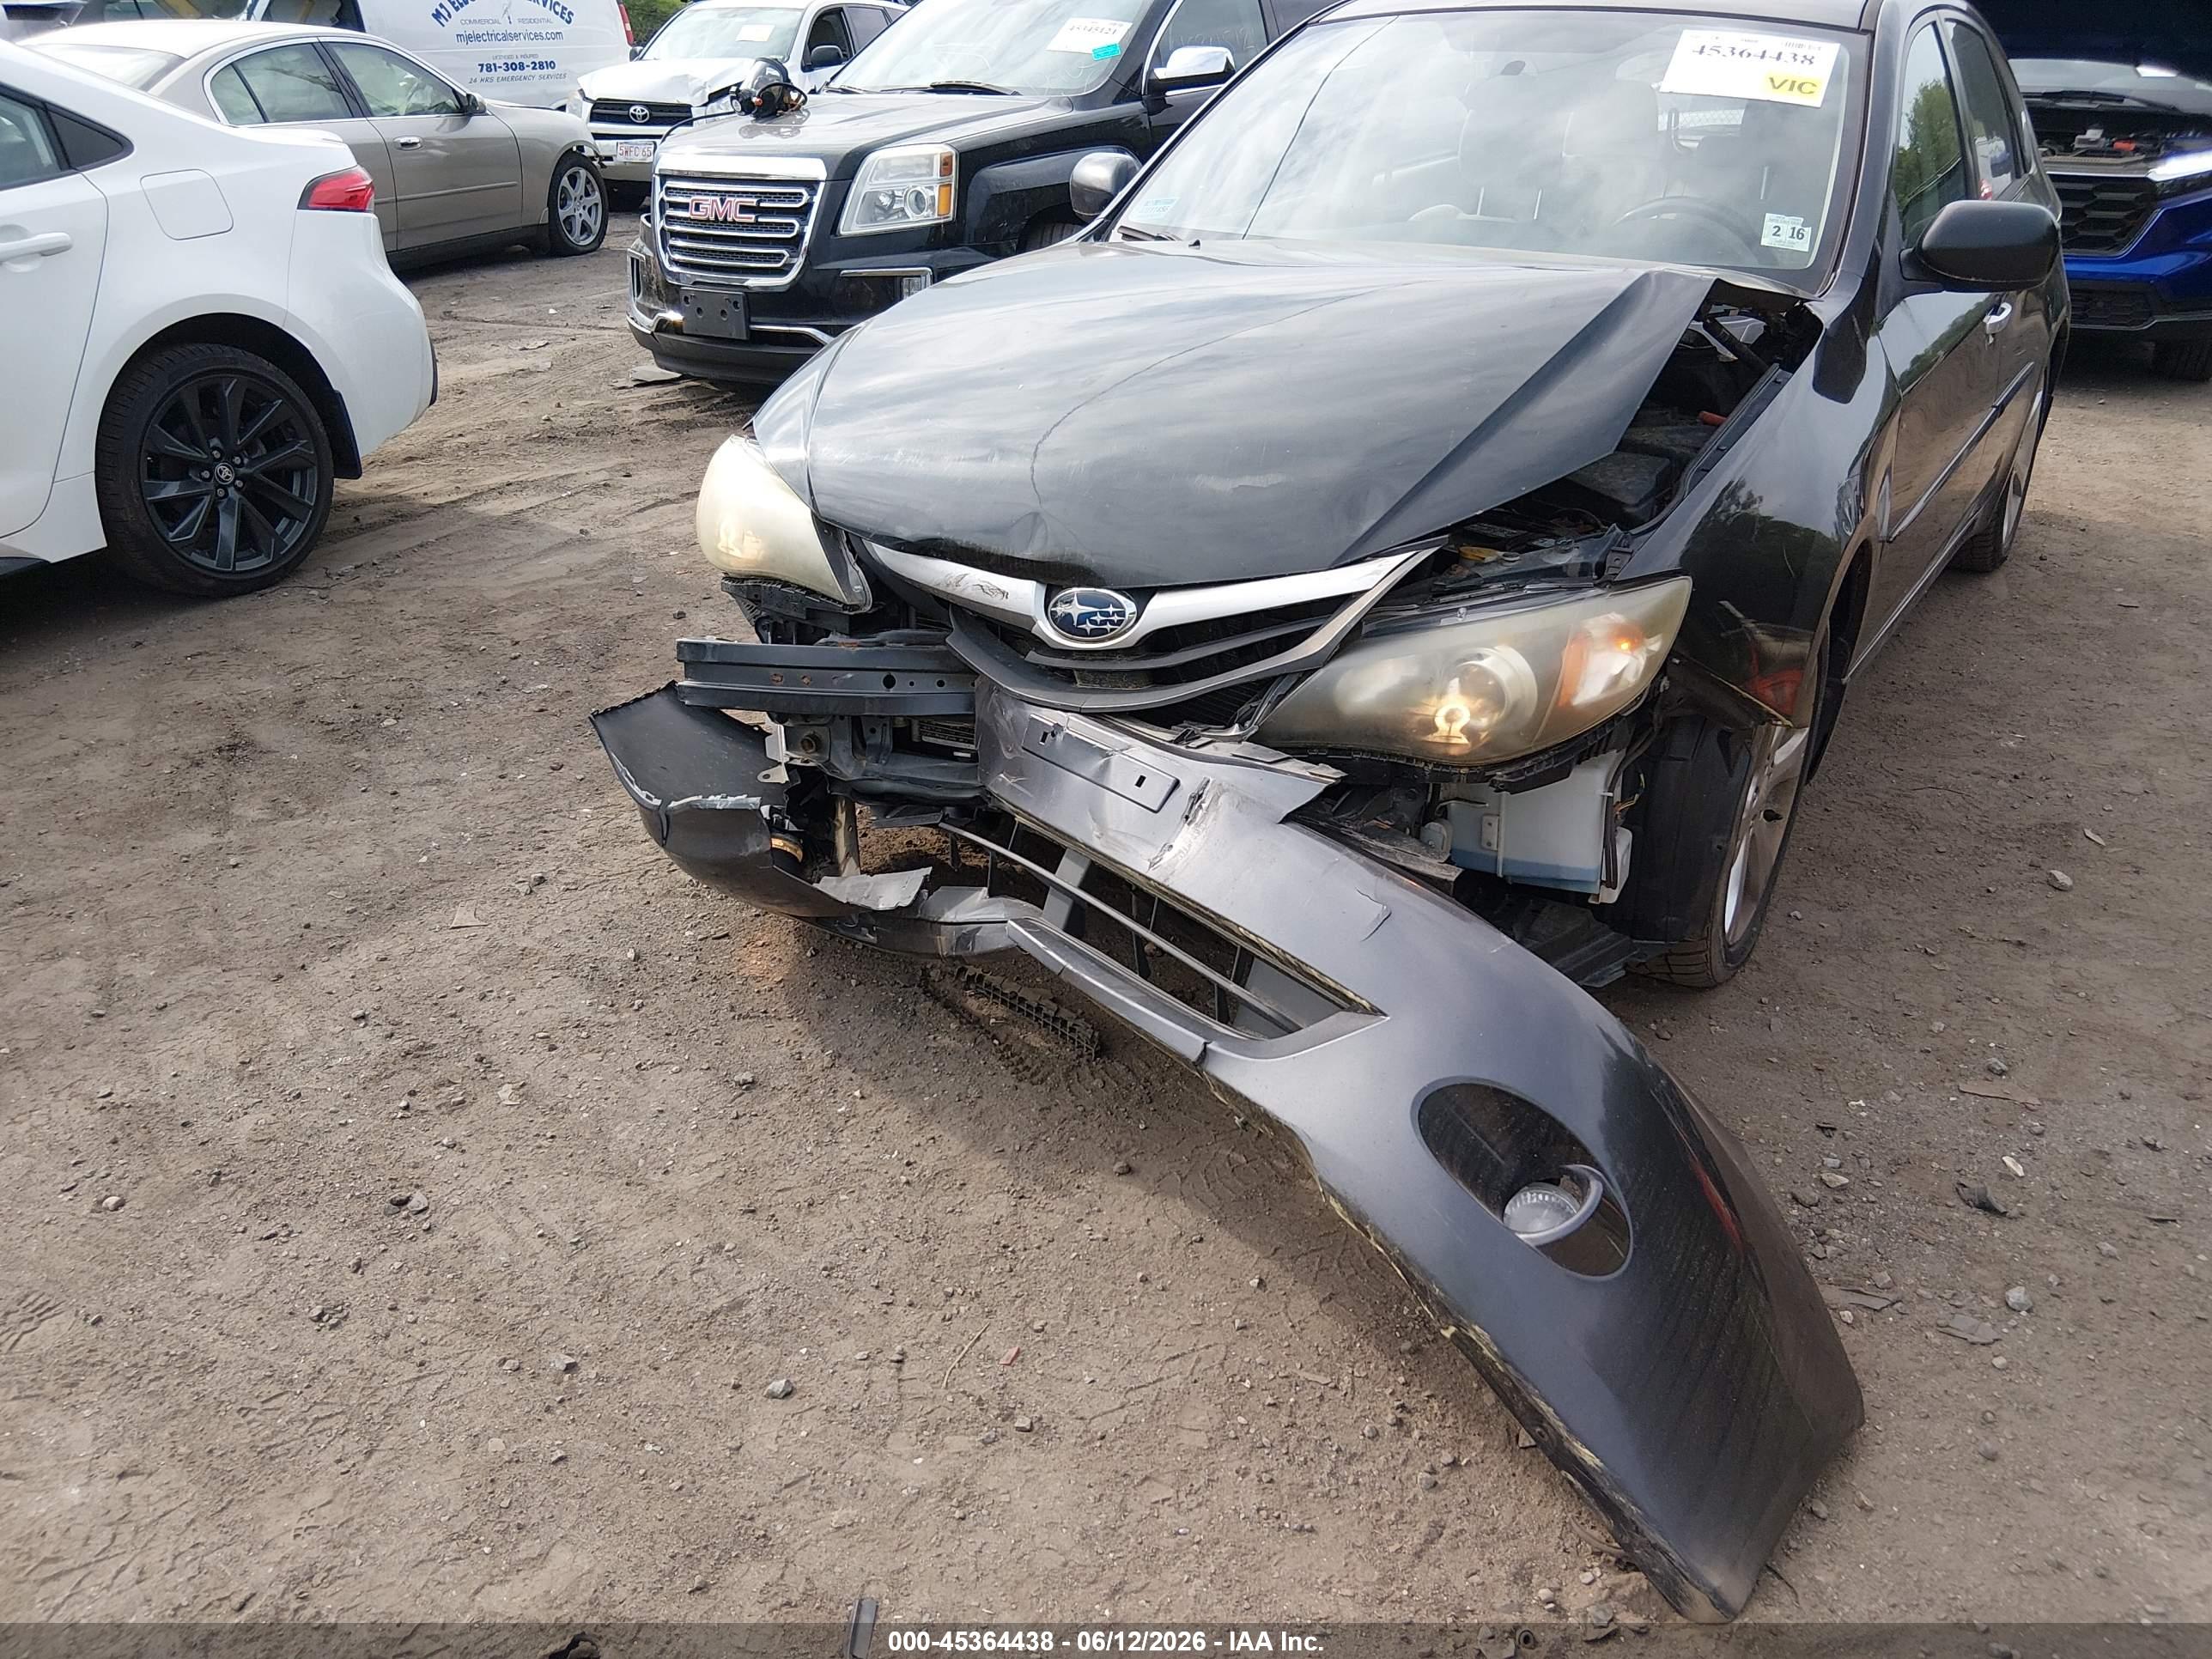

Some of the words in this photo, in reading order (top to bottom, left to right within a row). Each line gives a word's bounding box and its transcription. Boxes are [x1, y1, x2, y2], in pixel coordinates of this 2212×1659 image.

[431, 3, 453, 27] MJ
[456, 29, 564, 46] mjelectricalservices.com
[1692, 45, 1815, 65] 45364438
[477, 60, 556, 73] 781-308-2810
[1769, 76, 1818, 94] VIC
[690, 197, 757, 223] GMC
[1771, 225, 1781, 237] 2
[1789, 226, 1806, 240] 16
